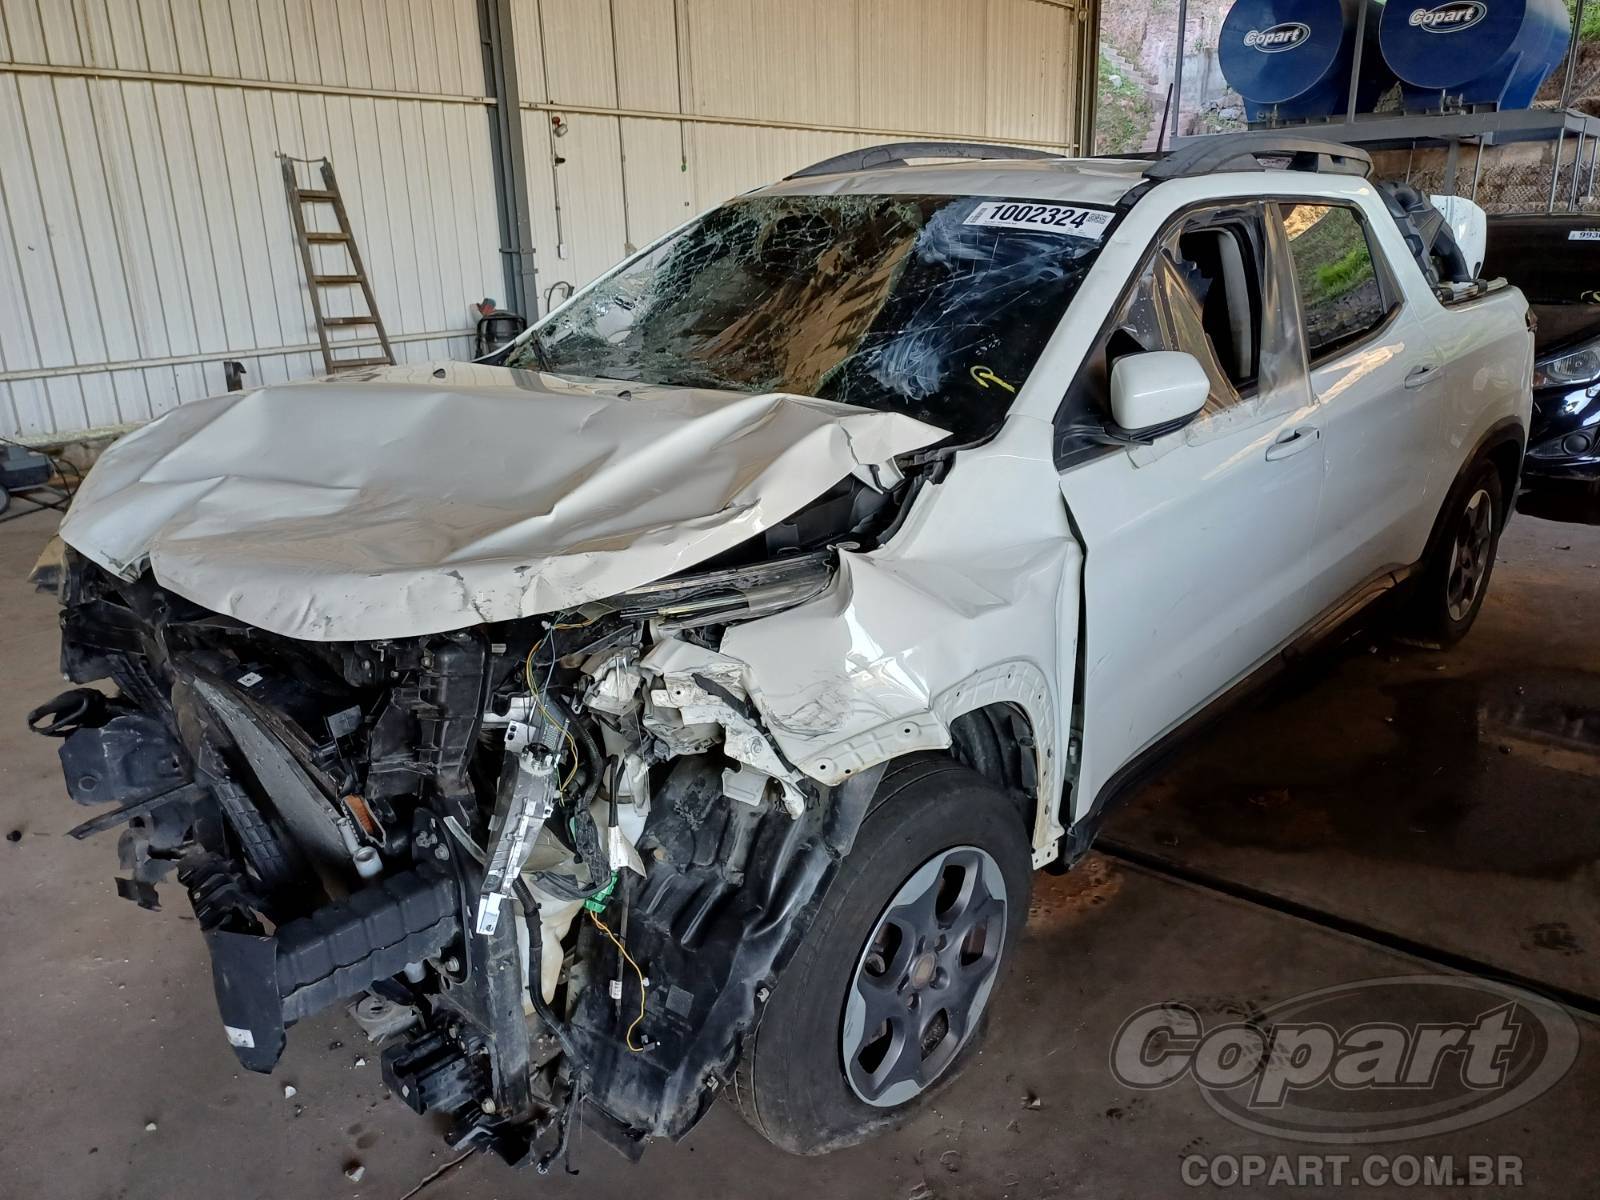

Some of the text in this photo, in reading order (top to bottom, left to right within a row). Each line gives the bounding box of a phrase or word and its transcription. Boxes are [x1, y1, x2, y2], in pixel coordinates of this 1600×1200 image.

[1409, 7, 1474, 27] Copart
[1244, 29, 1300, 47] Copart
[990, 204, 1089, 229] 1002324
